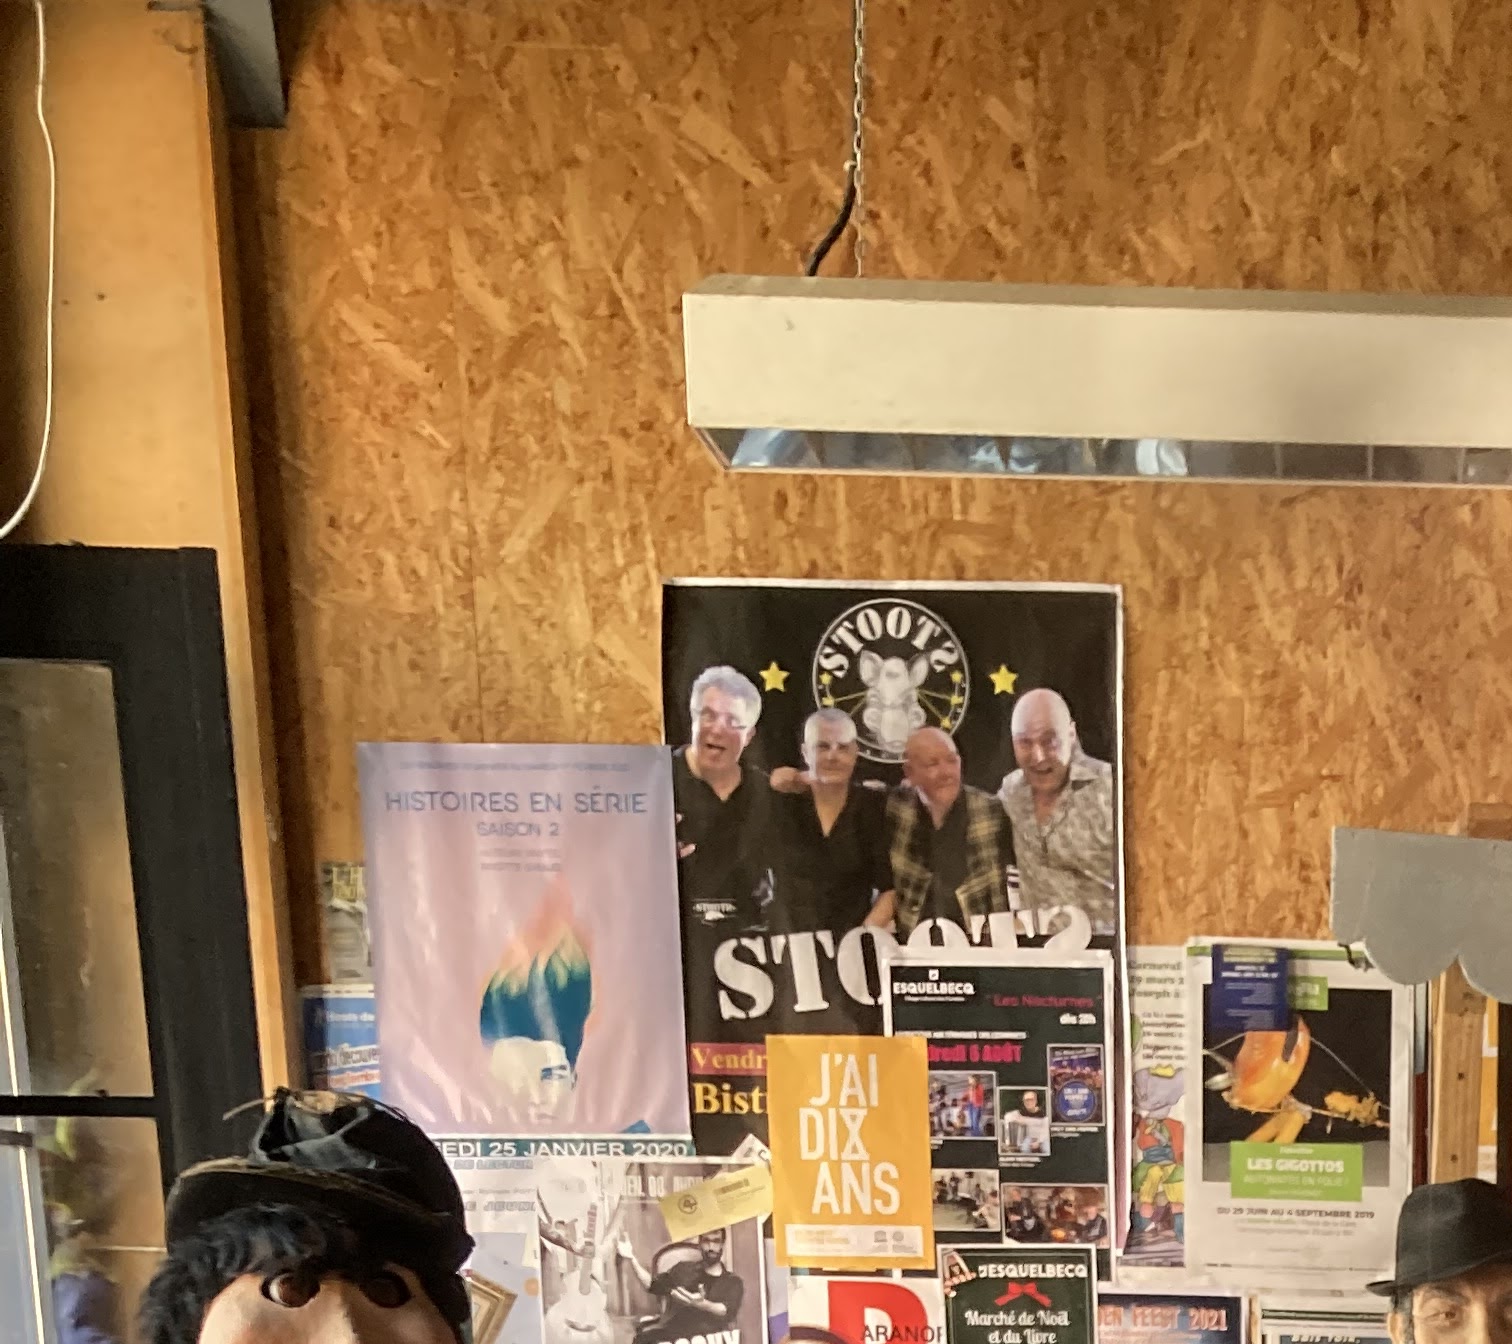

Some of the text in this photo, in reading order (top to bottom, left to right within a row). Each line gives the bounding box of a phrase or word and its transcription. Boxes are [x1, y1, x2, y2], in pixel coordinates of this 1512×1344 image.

[818, 606, 960, 679] STOOTS
[385, 786, 648, 814] HISTOIRES EN SÉRIE
[477, 821, 560, 837] SAISON 2
[893, 982, 975, 995] ESQUELBECQ
[810, 1053, 878, 1108] J'AI
[799, 1108, 869, 1161] DIX
[489, 1142, 516, 1157] 25
[524, 1142, 625, 1157] JANVIER
[632, 1142, 688, 1157] 2020
[1247, 1158, 1344, 1173] LES GIGOTTOS
[811, 1163, 900, 1215] ANS
[1232, 1207, 1244, 1216] 29
[1295, 1209, 1352, 1219] SEPTEMBRE
[1355, 1210, 1375, 1219] 2019
[987, 1264, 1088, 1279] ESQUELBECQ
[965, 1309, 1069, 1326] Marché de Noël
[1131, 1305, 1180, 1329] FEEST
[1189, 1308, 1227, 1331] 2021
[988, 1331, 1002, 1344] et
[1005, 1331, 1022, 1344] du
